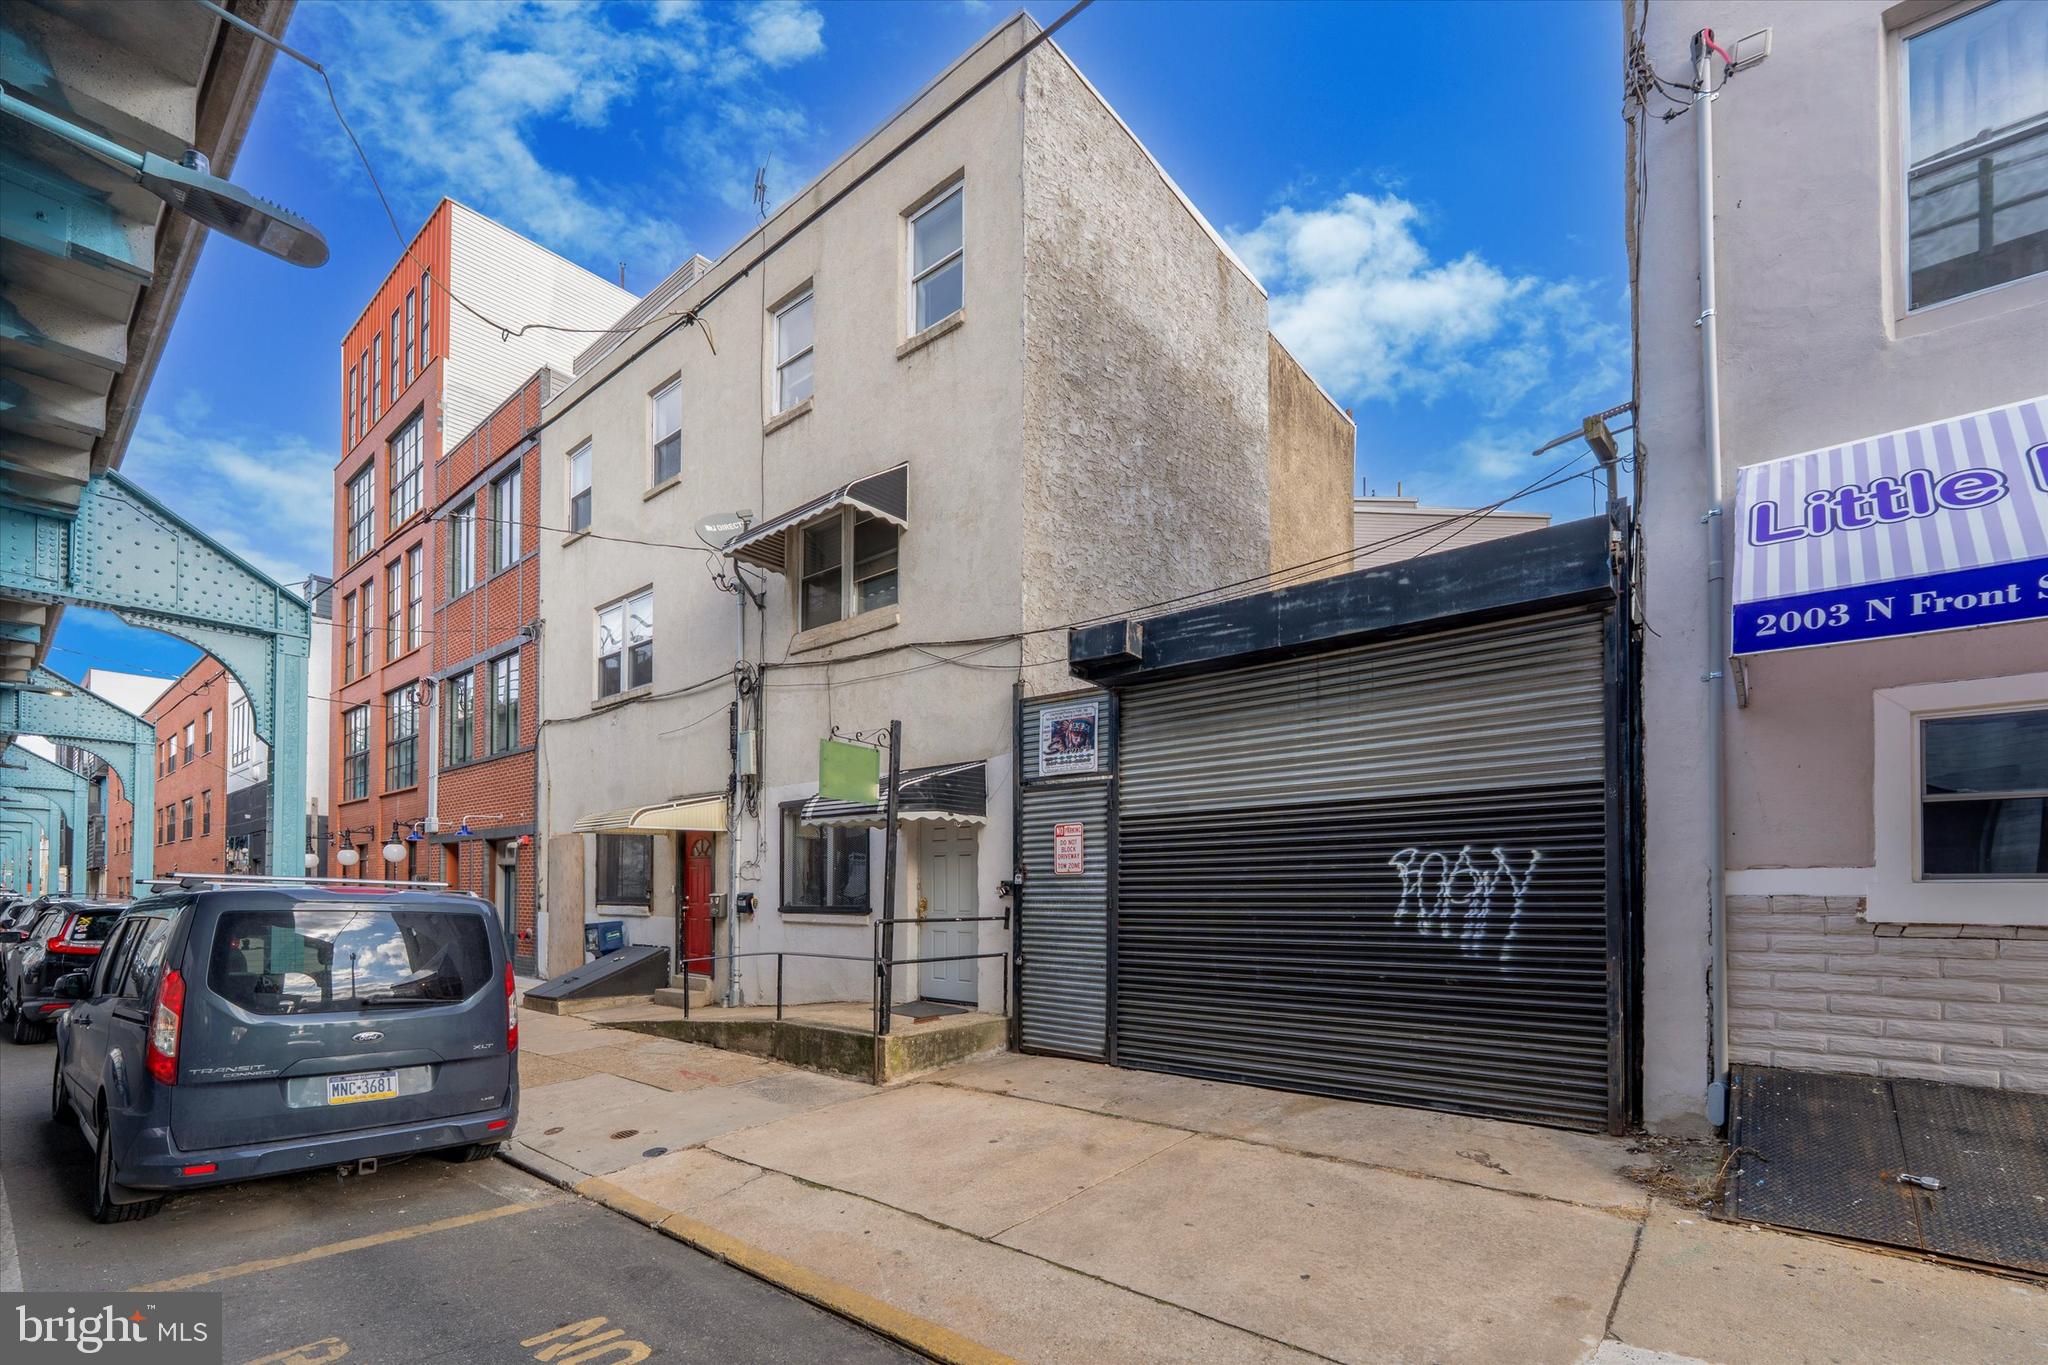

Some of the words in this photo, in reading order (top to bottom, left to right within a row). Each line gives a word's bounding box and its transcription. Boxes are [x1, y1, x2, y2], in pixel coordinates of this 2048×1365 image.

[1750, 468, 2010, 547] Little
[1755, 603, 1850, 637] 2003
[1865, 596, 1897, 622] N
[1910, 583, 2022, 616] Front
[189, 1064, 266, 1075] TRANSIT
[223, 1069, 280, 1078] CONNECT
